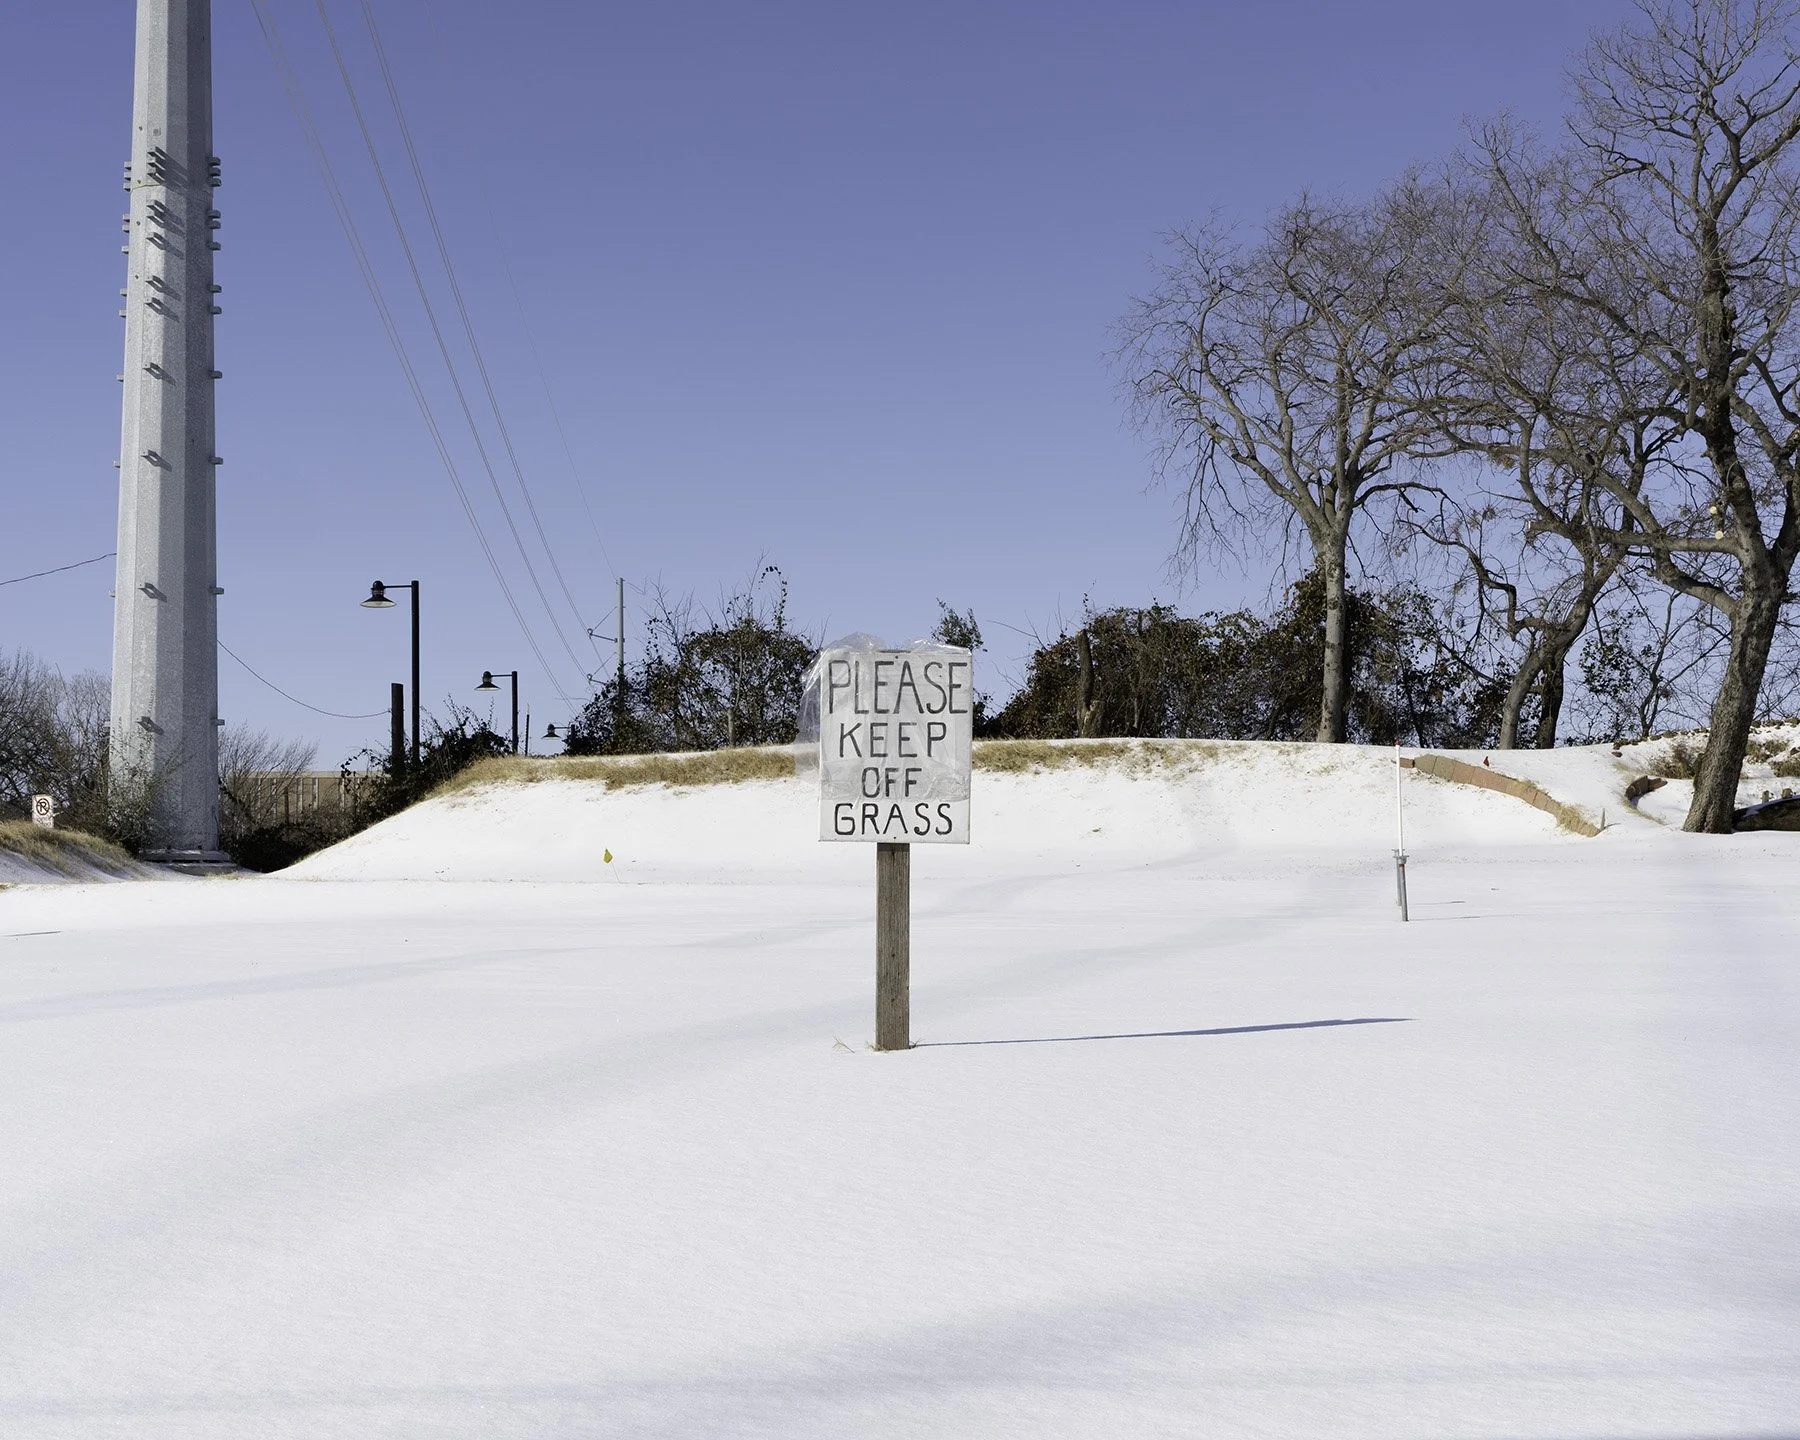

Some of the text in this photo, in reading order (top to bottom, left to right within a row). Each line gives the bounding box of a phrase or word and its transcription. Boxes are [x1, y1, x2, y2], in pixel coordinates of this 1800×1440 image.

[828, 660, 968, 715] PLEASE
[839, 722, 947, 758] KEEP
[861, 767, 922, 799] OFF
[834, 802, 953, 836] GRASS
